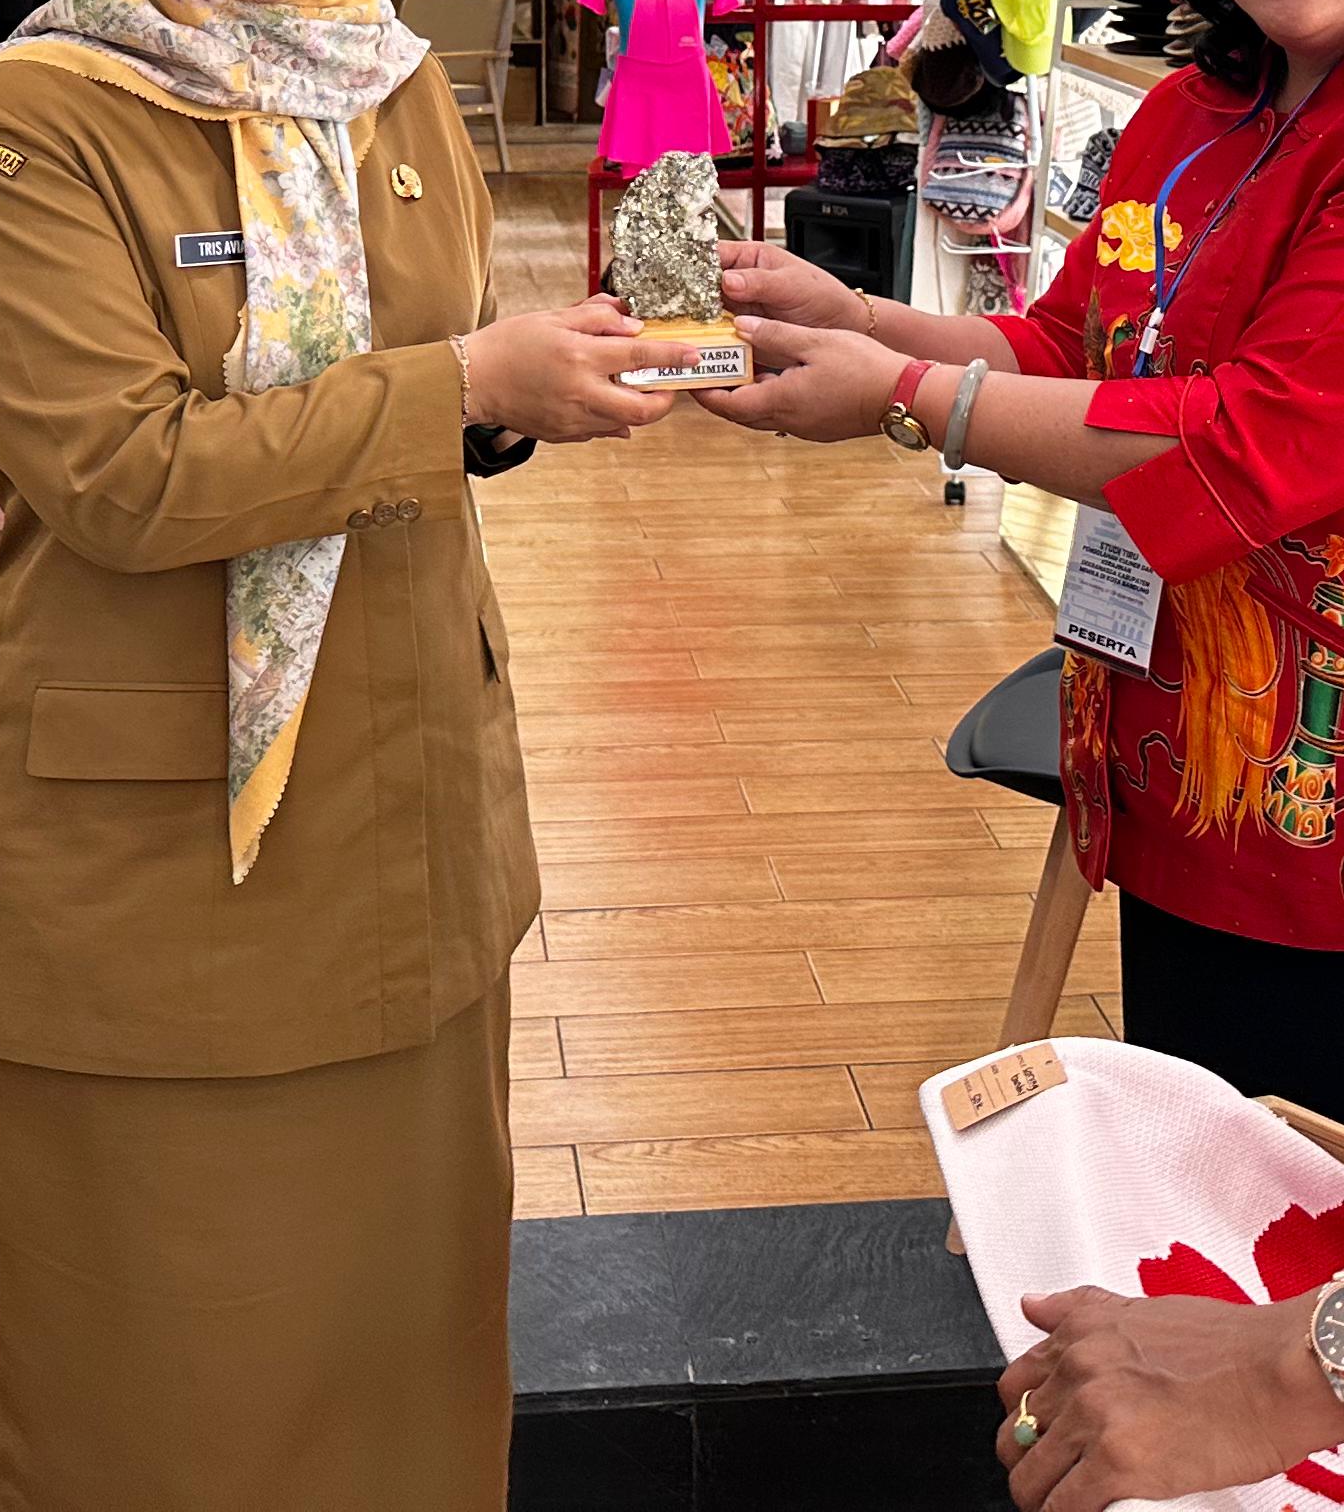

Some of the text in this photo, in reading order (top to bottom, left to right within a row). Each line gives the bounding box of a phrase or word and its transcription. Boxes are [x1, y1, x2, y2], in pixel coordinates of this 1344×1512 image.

[198, 240, 223, 257] TRIS
[699, 350, 740, 361] NASDA
[691, 363, 739, 375] MIMIKA
[1067, 623, 1137, 659] PESERTA
